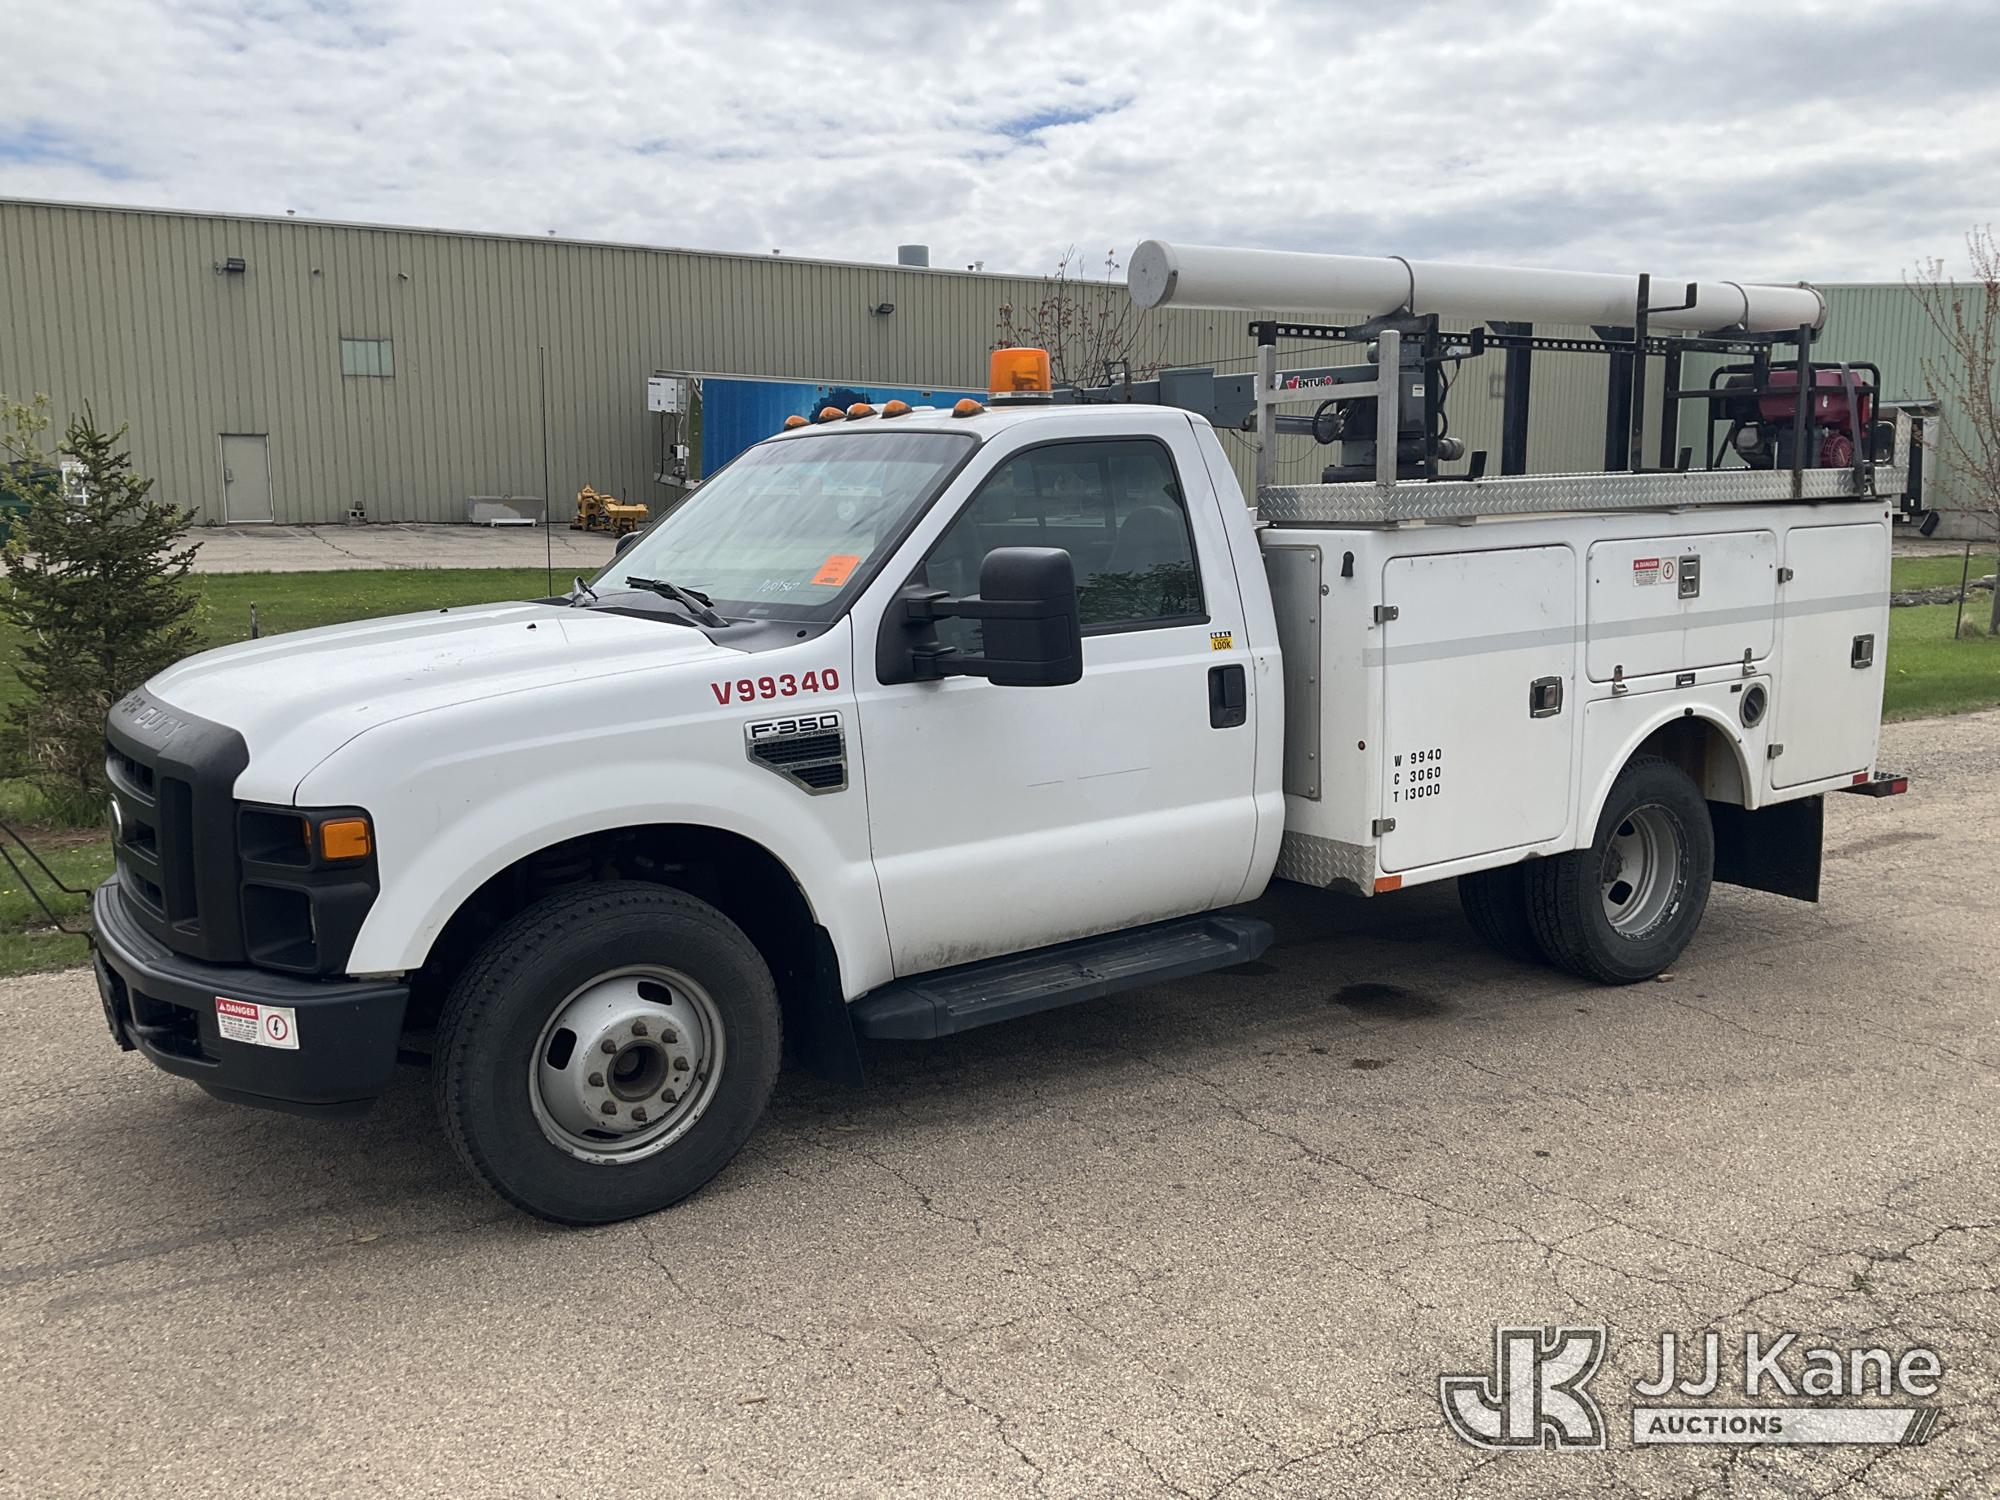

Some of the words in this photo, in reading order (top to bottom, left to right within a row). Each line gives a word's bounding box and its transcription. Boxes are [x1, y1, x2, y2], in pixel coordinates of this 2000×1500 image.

[1286, 376, 1333, 389] VENTURO
[1213, 641, 1231, 650] LOOK
[711, 668, 840, 705] V99340
[1394, 754, 1402, 767] W
[1410, 748, 1442, 765] 9940
[1394, 773, 1400, 785] C
[1410, 766, 1441, 783] 3060
[1393, 791, 1399, 803] T
[1405, 783, 1440, 801] 13000
[226, 1003, 256, 1017] DANGER
